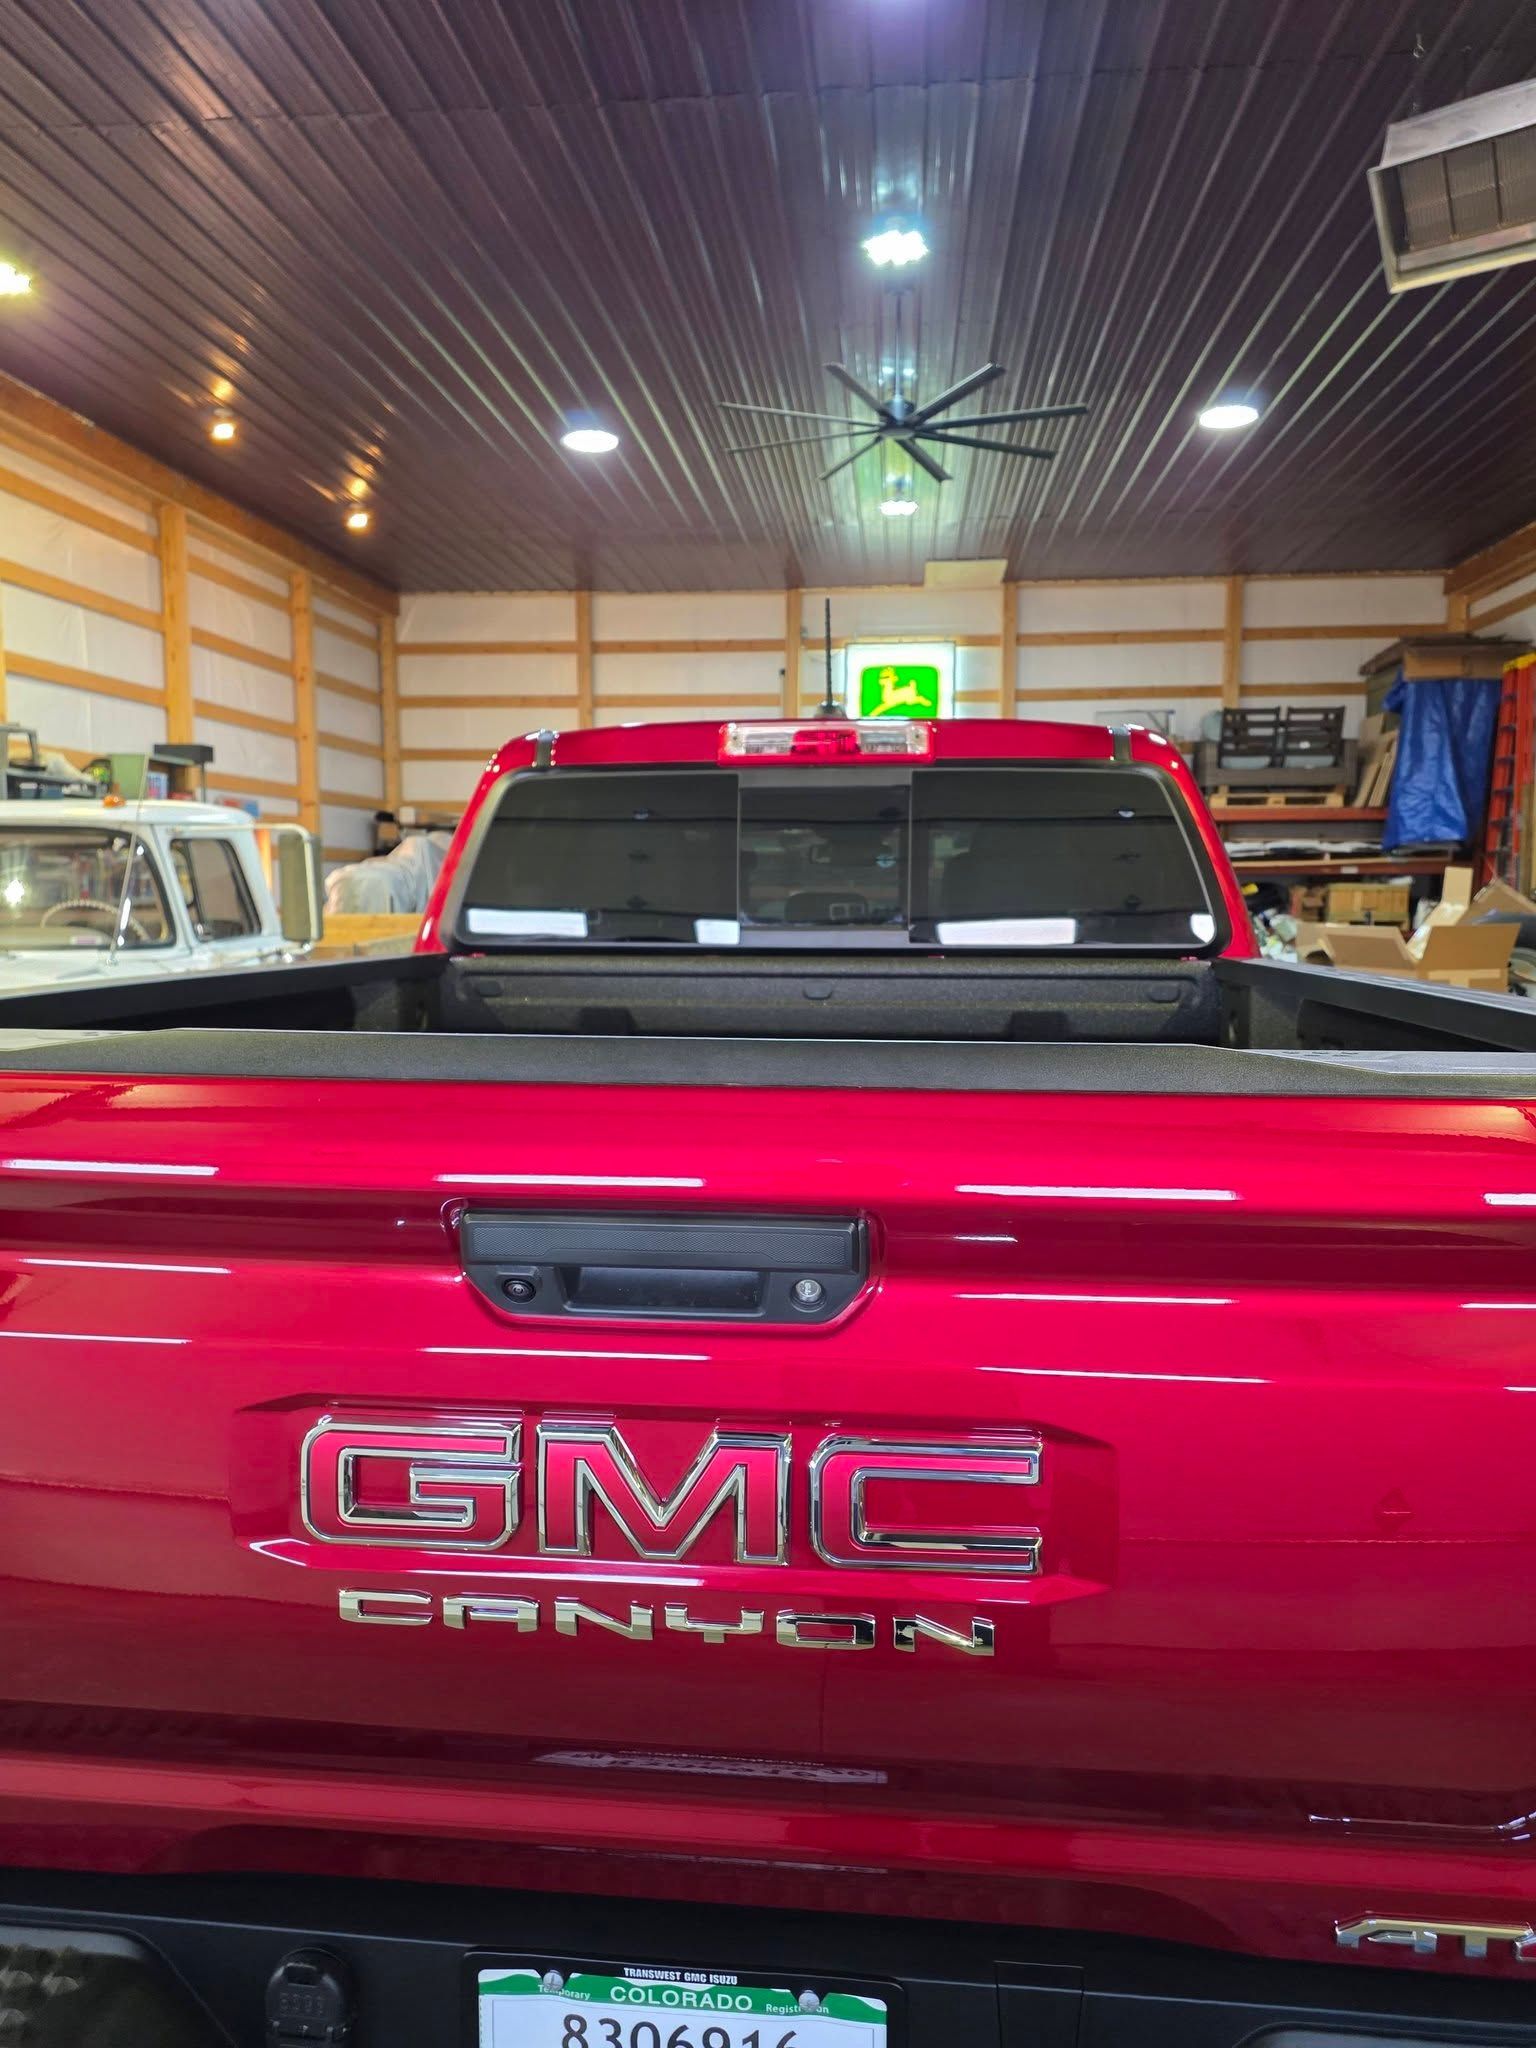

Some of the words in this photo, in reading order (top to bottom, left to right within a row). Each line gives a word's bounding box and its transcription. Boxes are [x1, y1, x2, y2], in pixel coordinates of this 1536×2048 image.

[299, 1416, 1045, 1574] GMC
[338, 1587, 998, 1657] CANYON
[1335, 1914, 1536, 1961] AT
[537, 1984, 591, 2001] Teporary
[609, 1985, 753, 2011] COLORADO
[765, 2003, 830, 2015] Registon
[623, 1967, 682, 1981] TRANSWEST
[684, 1972, 707, 1983] GMC
[709, 1974, 738, 1985] ISUZU
